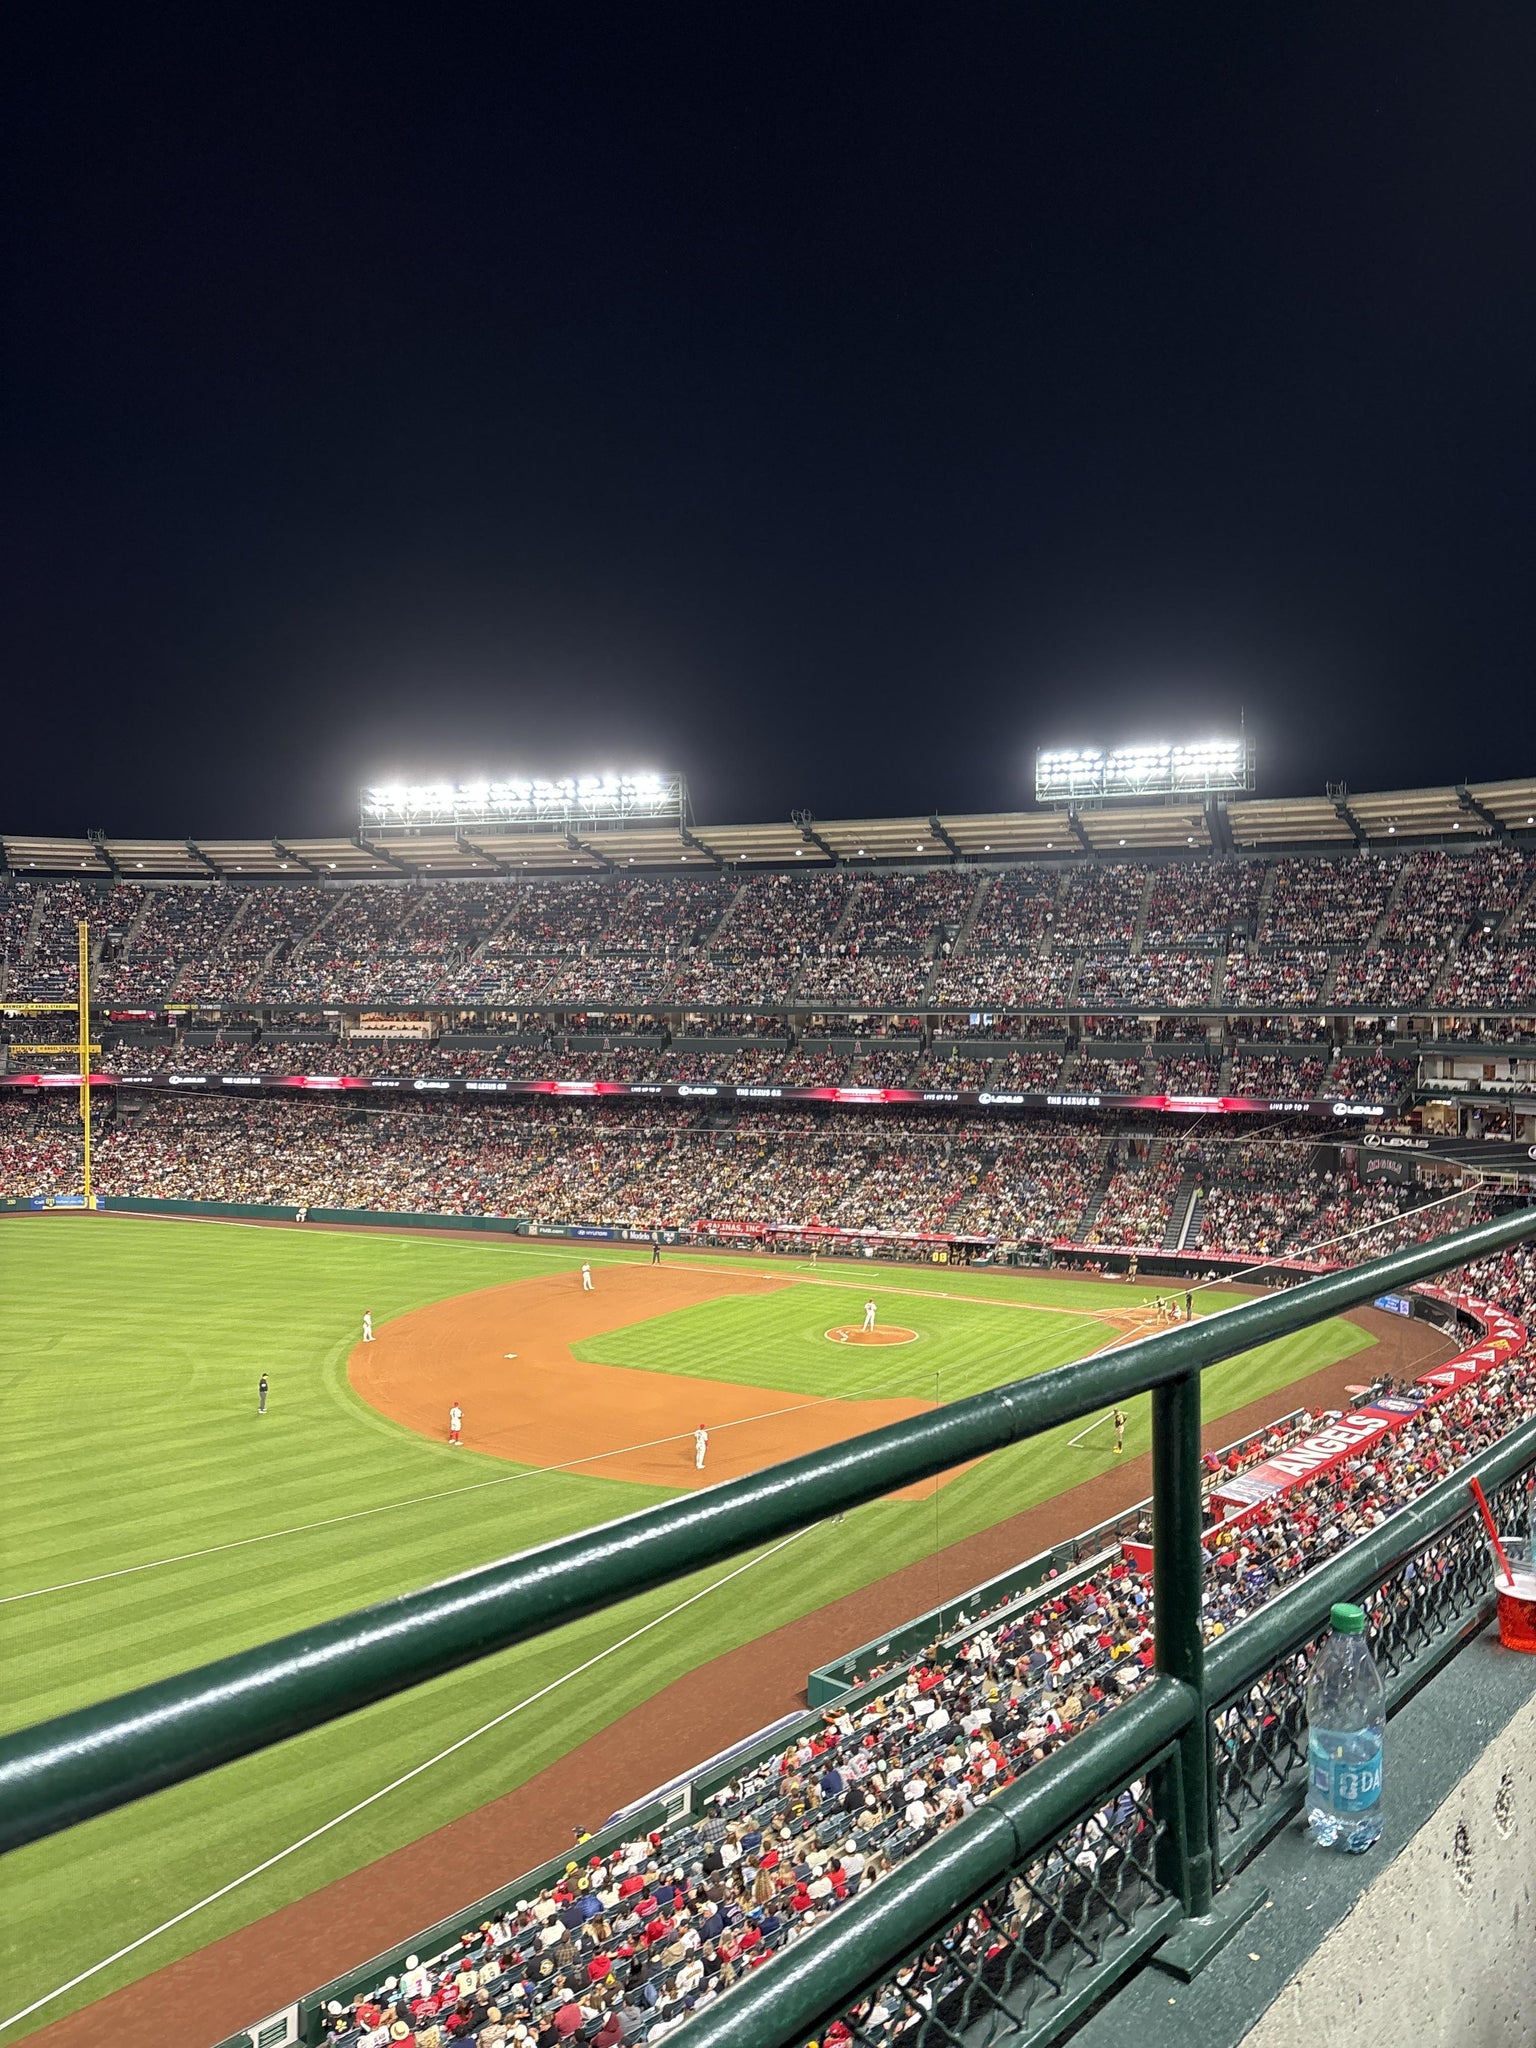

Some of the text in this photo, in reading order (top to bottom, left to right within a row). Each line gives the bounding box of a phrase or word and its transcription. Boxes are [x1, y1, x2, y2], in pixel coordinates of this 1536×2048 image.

[1046, 1096, 1061, 1105] THE
[1062, 1096, 1087, 1105] LEXUS
[1381, 1136, 1430, 1148] LEXUS
[585, 1229, 608, 1237] HYUNDAI
[629, 1231, 650, 1240] Modelo
[1265, 1415, 1389, 1477] ANGELS
